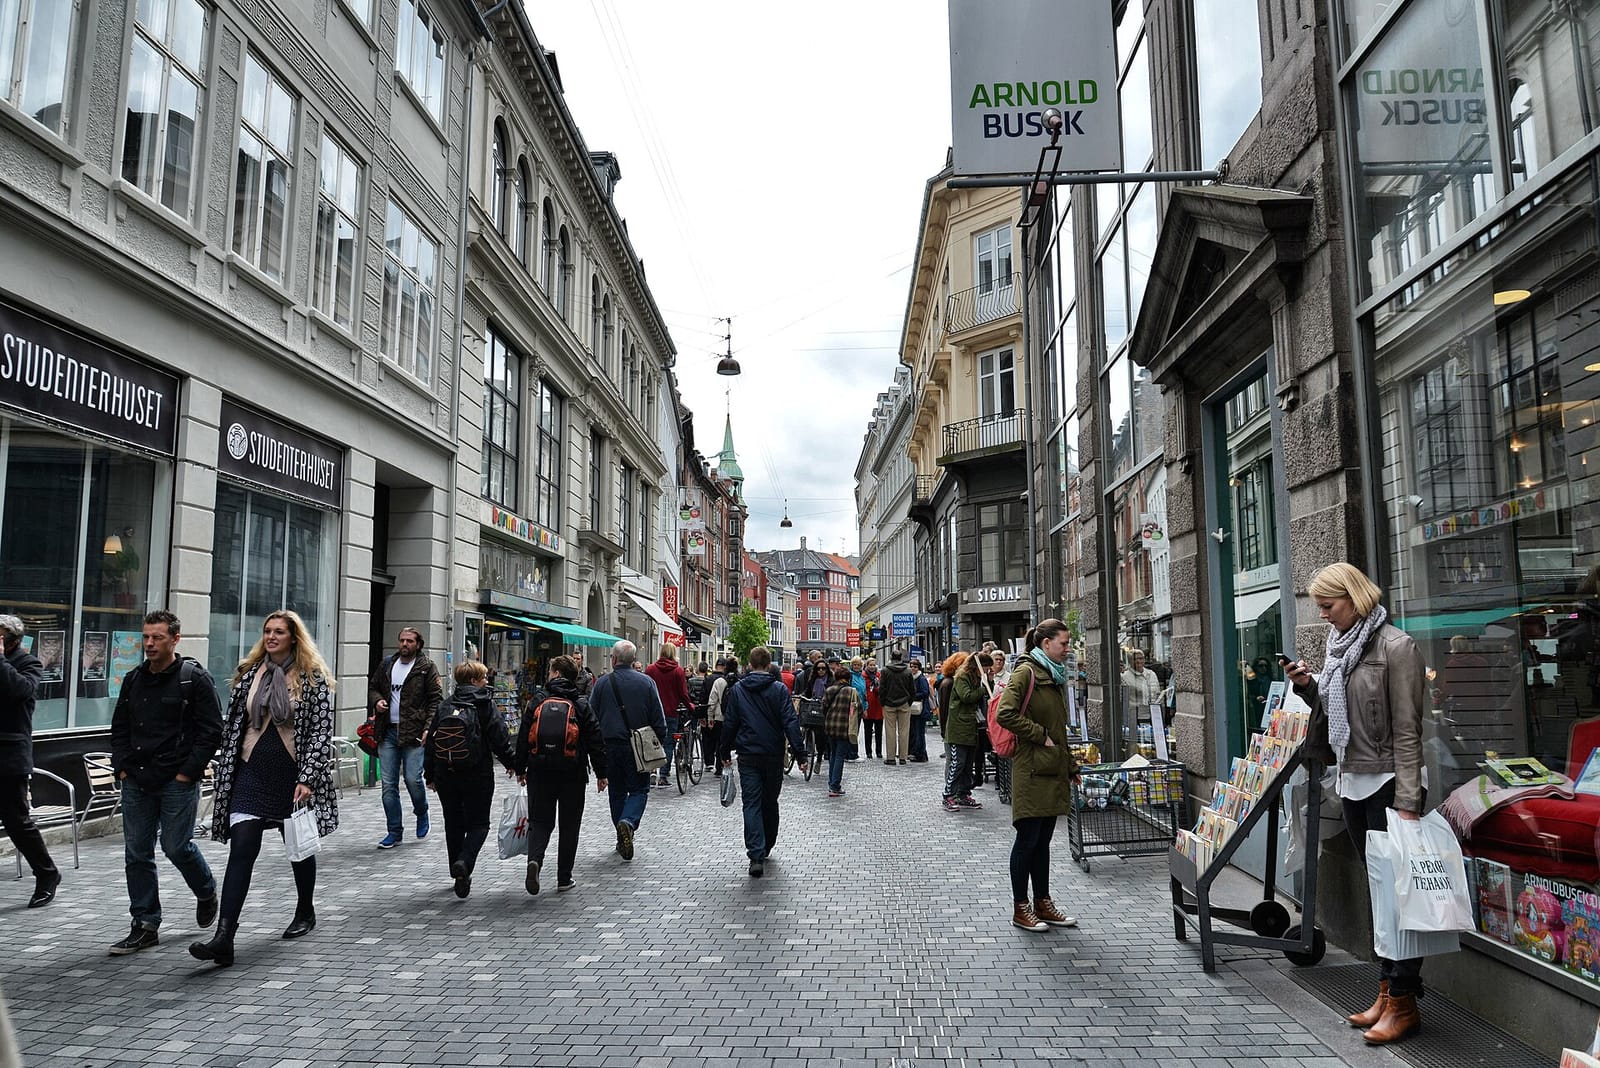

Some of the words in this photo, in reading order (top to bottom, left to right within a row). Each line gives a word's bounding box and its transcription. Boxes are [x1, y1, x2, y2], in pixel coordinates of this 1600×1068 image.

[969, 79, 1099, 108] ARNOLD
[983, 109, 1085, 139] BUSK
[977, 586, 1021, 602] SIGNAL
[917, 615, 942, 624] SIGNAL
